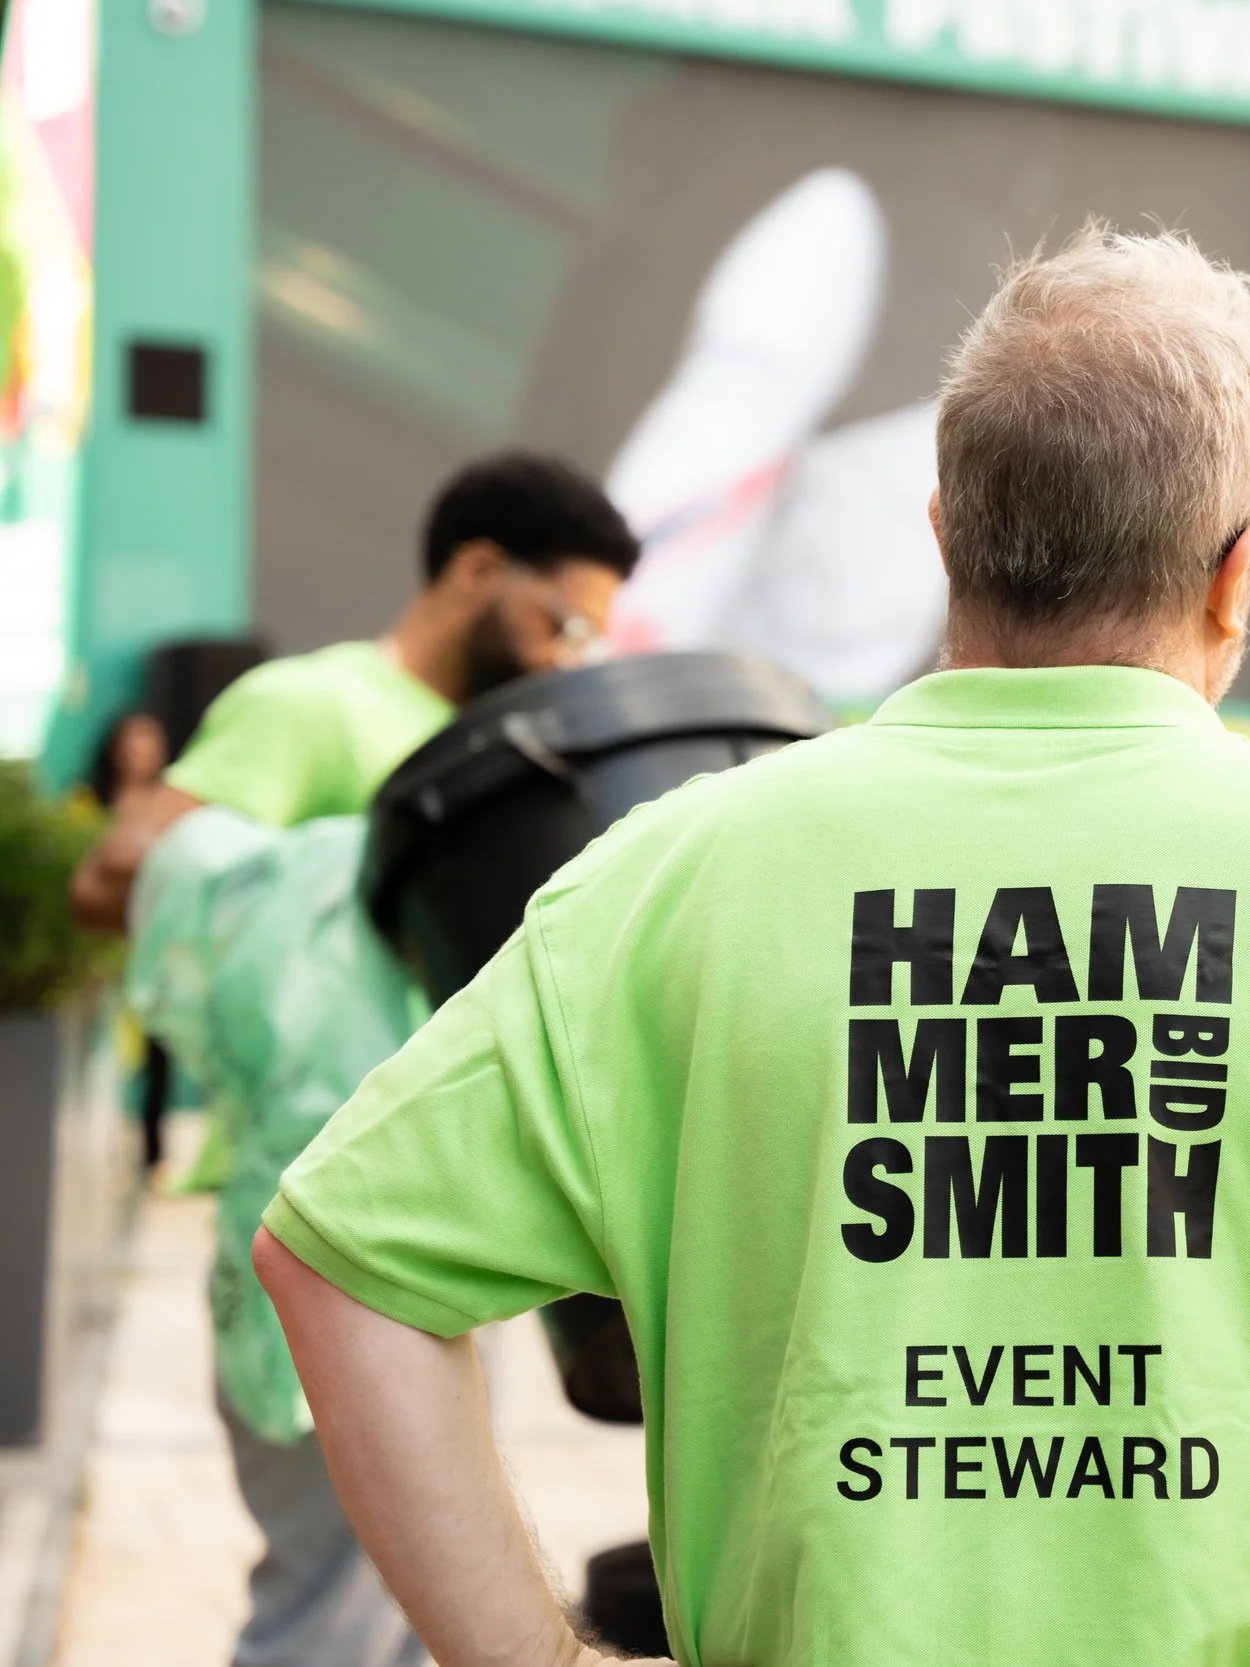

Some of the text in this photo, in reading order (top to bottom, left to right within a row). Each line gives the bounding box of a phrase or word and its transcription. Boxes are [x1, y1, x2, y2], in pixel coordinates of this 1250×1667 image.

[850, 884, 1236, 1006] HAM
[848, 1015, 1138, 1124] MER
[1149, 1013, 1230, 1132] BID
[840, 1133, 1222, 1264] SMITH
[905, 1344, 1163, 1407] EVENT
[836, 1436, 1221, 1502] STEWARD
